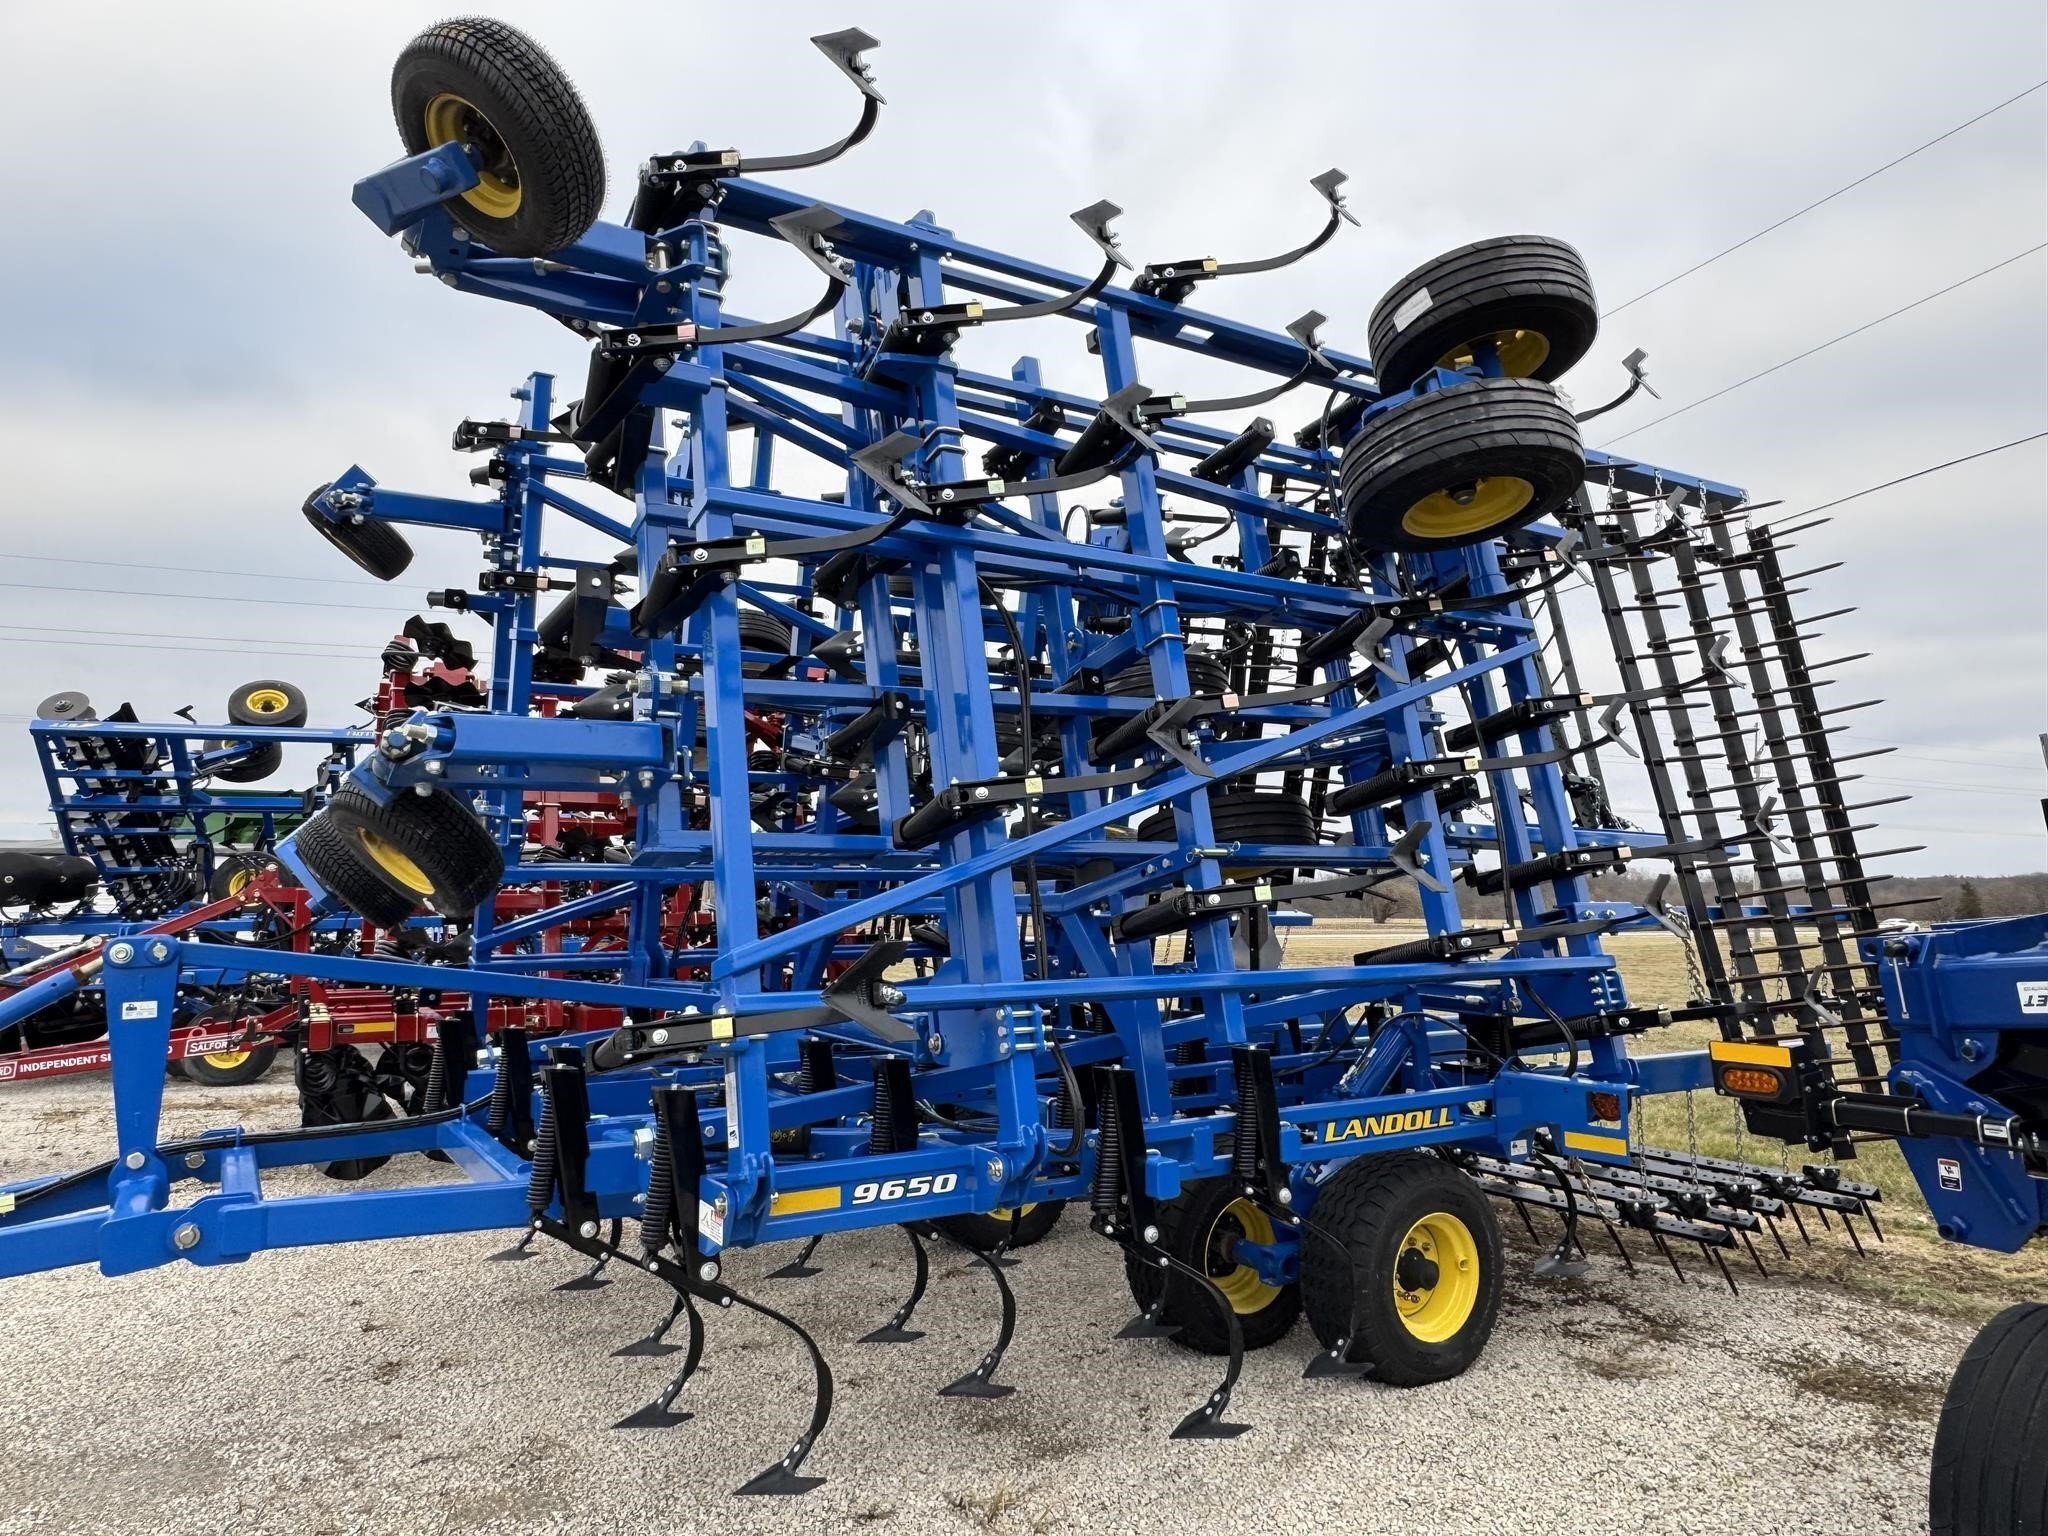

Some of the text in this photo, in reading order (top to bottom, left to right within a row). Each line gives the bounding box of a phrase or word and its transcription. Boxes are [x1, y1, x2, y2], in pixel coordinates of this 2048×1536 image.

[190, 1040, 232, 1053] SALFOR
[20, 1055, 97, 1072] INDEPENDENT
[1324, 1107, 1454, 1144] LANDOLL
[852, 1173, 958, 1205] 9650
